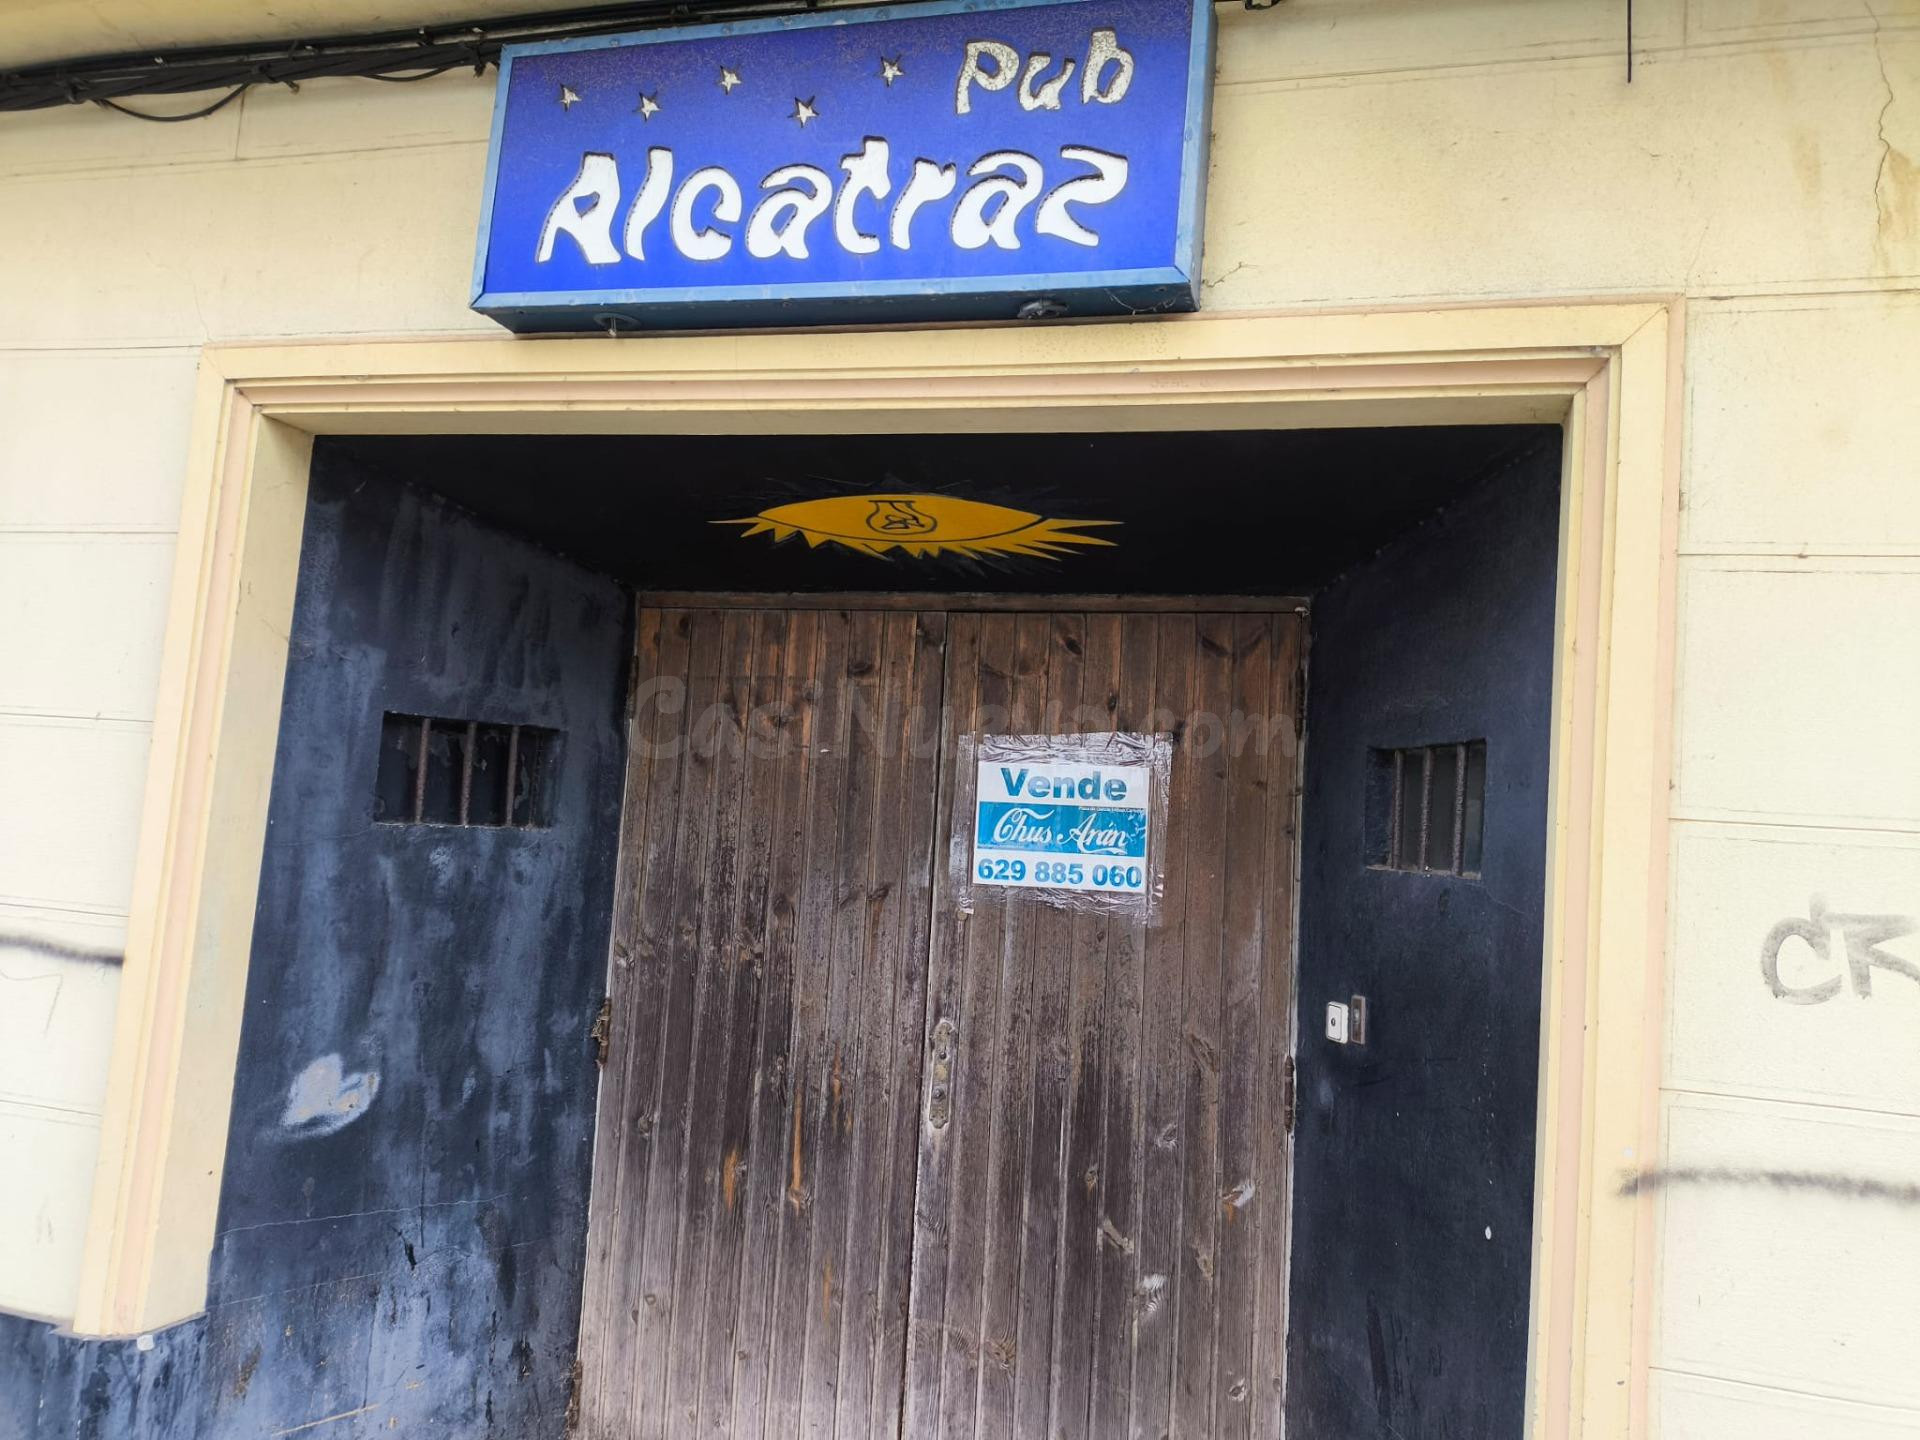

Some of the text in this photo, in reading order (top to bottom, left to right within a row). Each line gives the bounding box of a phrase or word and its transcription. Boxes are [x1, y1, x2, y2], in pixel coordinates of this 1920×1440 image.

[956, 28, 1134, 115] Pub
[537, 137, 1129, 264] Alcatraz
[1001, 767, 1127, 800] Vende
[994, 808, 1127, 855] Chus Arán
[978, 859, 1142, 888] 629 885 060
